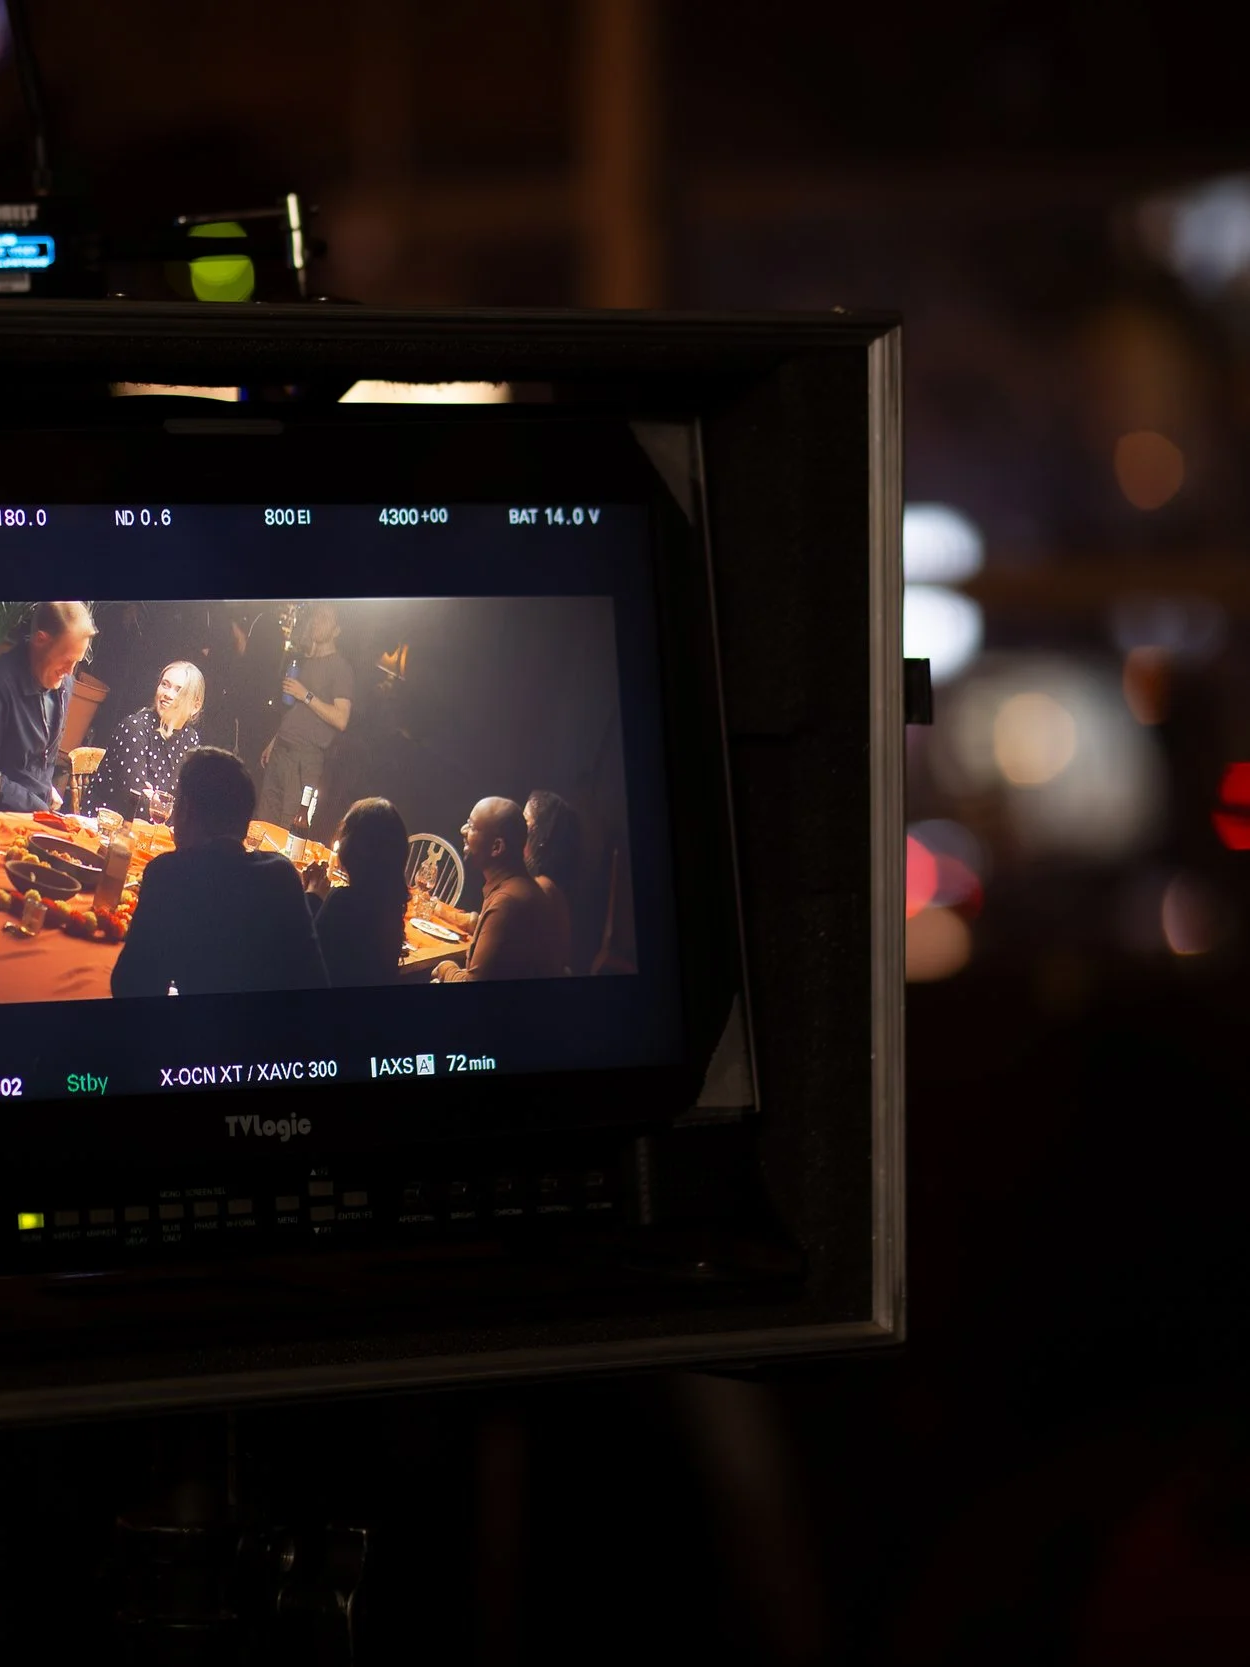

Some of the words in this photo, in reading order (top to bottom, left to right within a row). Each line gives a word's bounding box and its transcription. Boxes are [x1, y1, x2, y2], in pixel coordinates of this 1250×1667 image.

[115, 509, 135, 527] ND
[139, 509, 172, 527] 0.6
[378, 507, 449, 526] 4300+00
[508, 508, 539, 525] BAT
[544, 508, 584, 526] 14.0
[588, 508, 601, 525] V
[160, 1066, 217, 1087] X-OCN
[219, 1064, 243, 1083] XT
[247, 1064, 254, 1082] /
[257, 1061, 304, 1082] XAVC
[307, 1060, 338, 1079] 300
[378, 1057, 414, 1076] AXS
[66, 1073, 109, 1095] Stby
[225, 1112, 312, 1142] TVLogic
